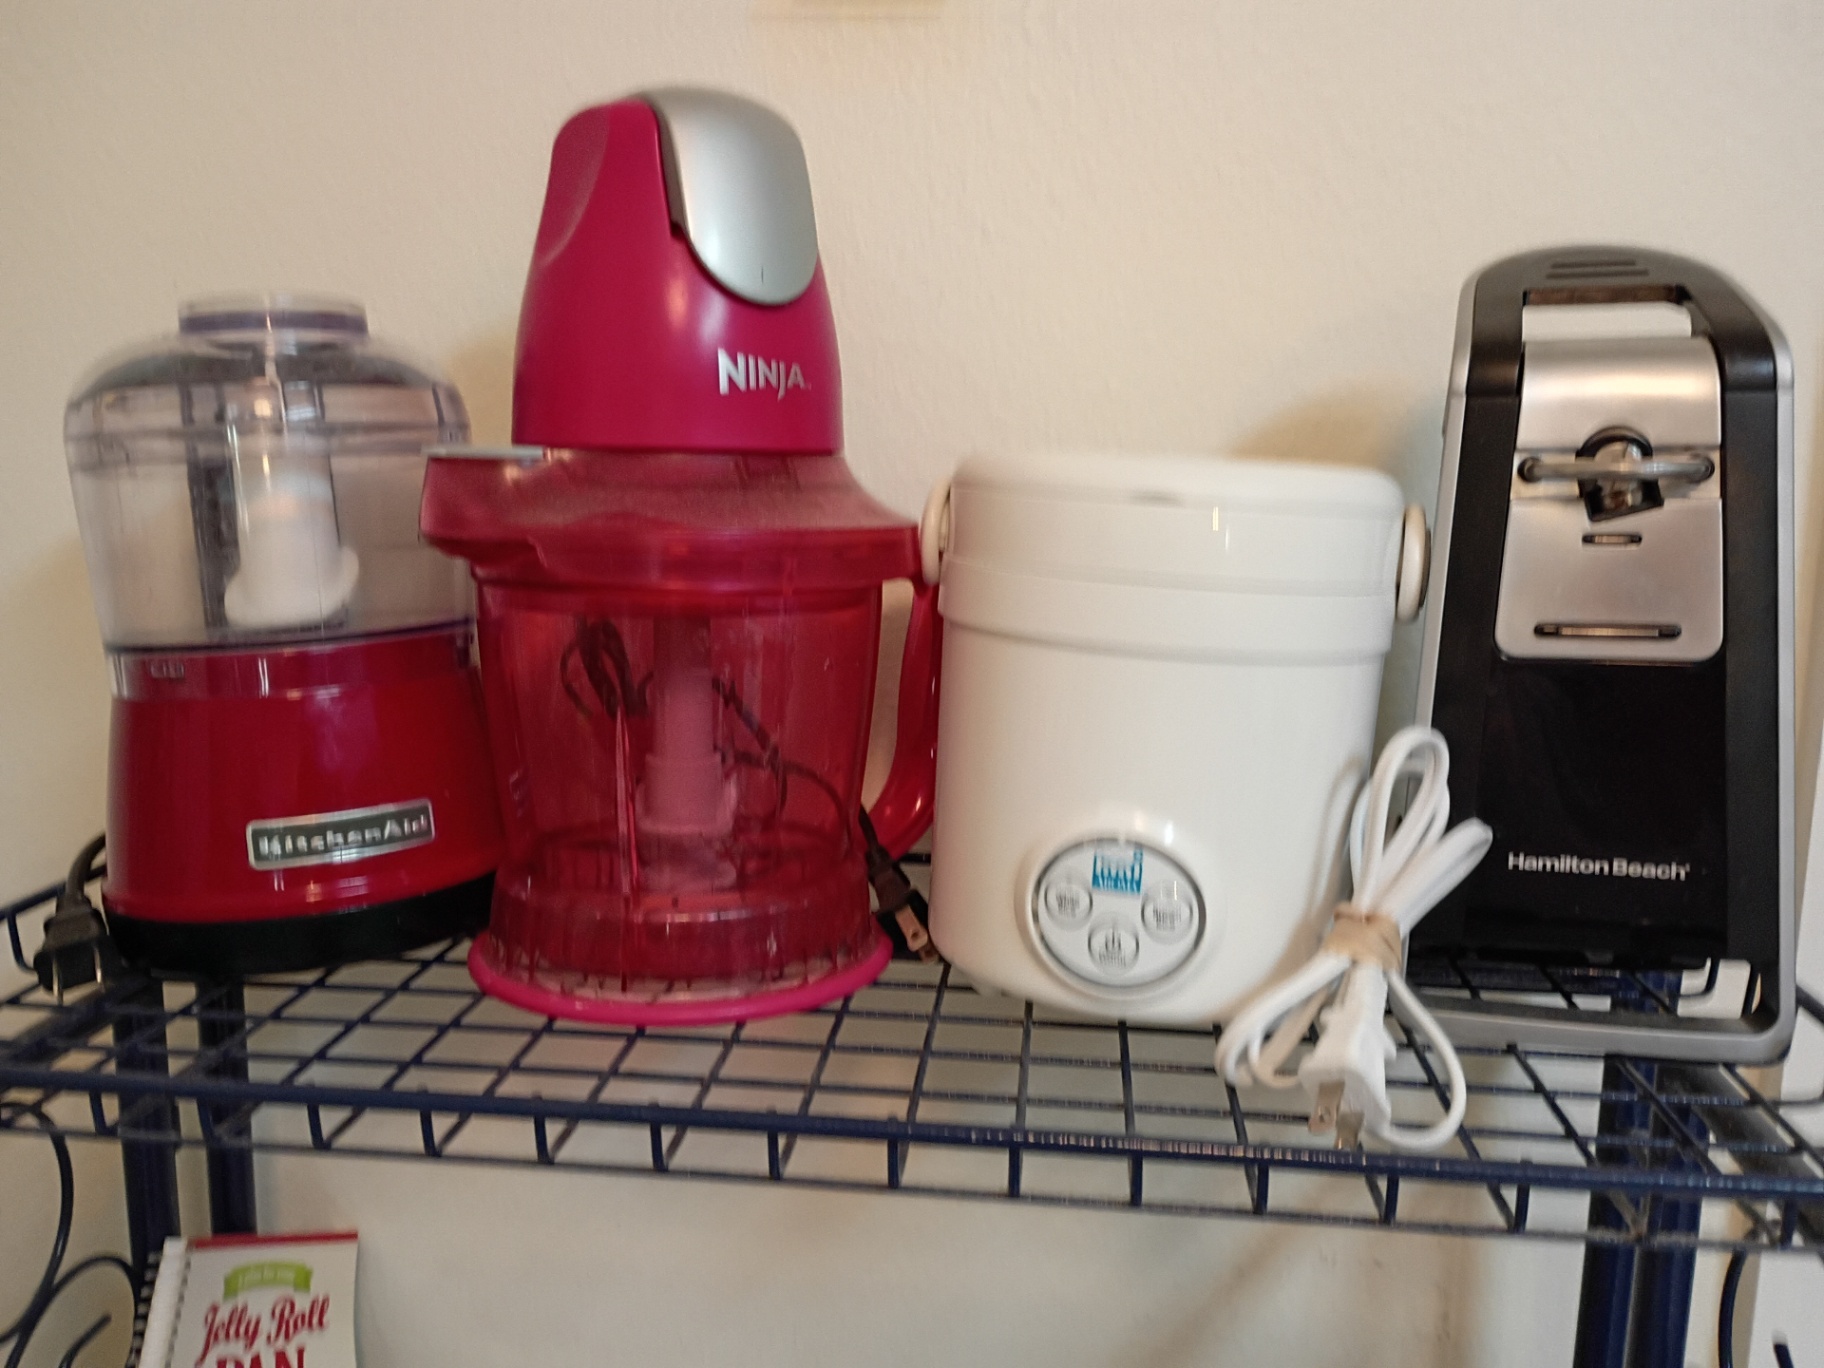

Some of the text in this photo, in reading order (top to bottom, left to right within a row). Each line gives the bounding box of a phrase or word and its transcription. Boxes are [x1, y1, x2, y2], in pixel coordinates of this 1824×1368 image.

[717, 347, 806, 401] NINJA
[258, 814, 428, 858] KitchenAid
[1508, 851, 1687, 881] Hamilton Beach
[195, 1294, 330, 1367] Jelly Roll
